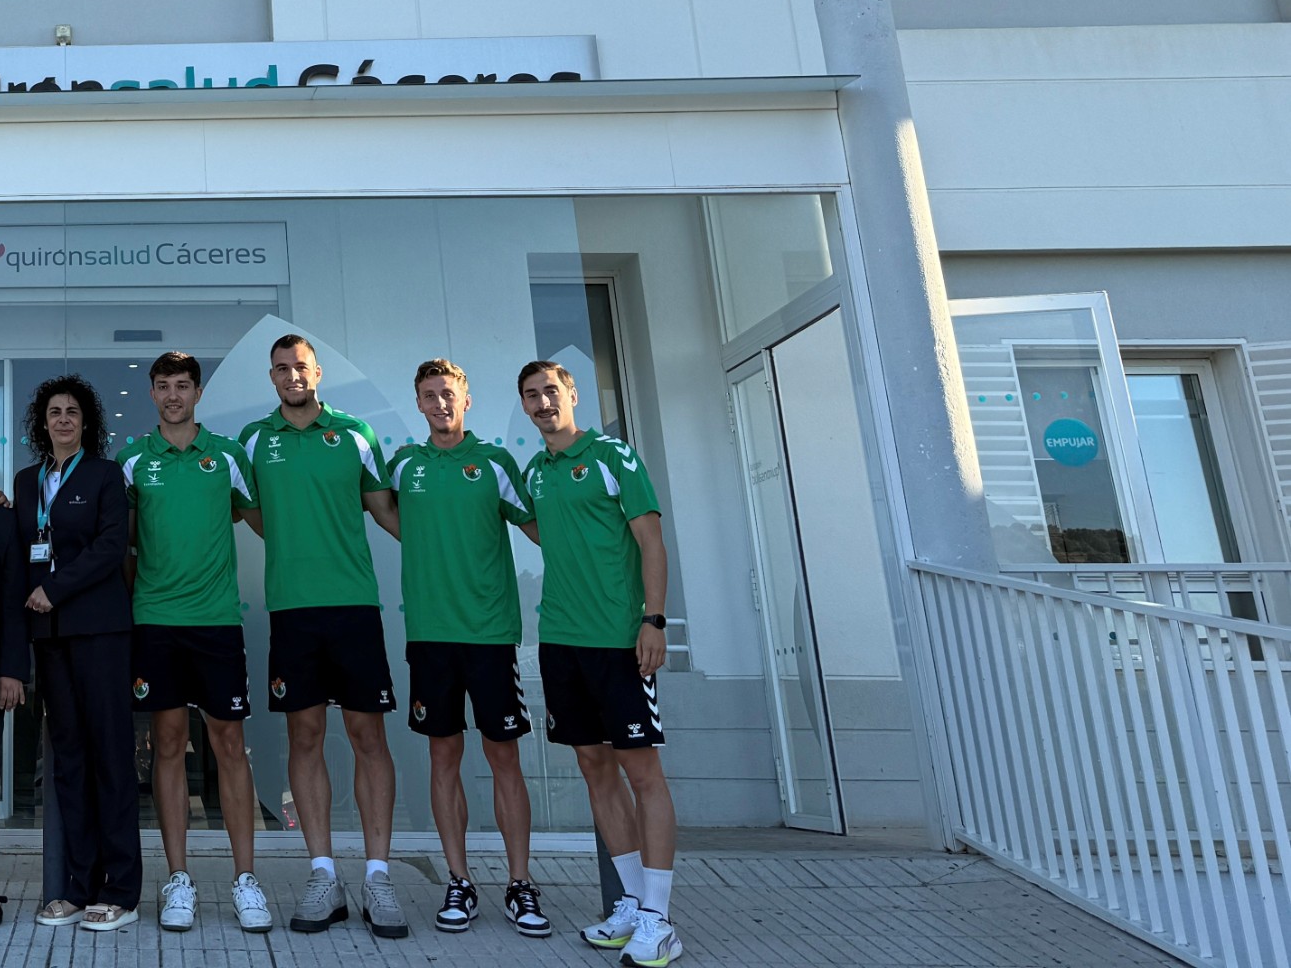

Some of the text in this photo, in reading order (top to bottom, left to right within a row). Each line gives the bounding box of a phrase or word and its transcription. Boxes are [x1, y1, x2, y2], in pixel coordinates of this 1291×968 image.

[6, 245, 150, 272] quirónsalud
[156, 243, 266, 265] Cáceres
[1045, 436, 1095, 448] EMPUJAR
